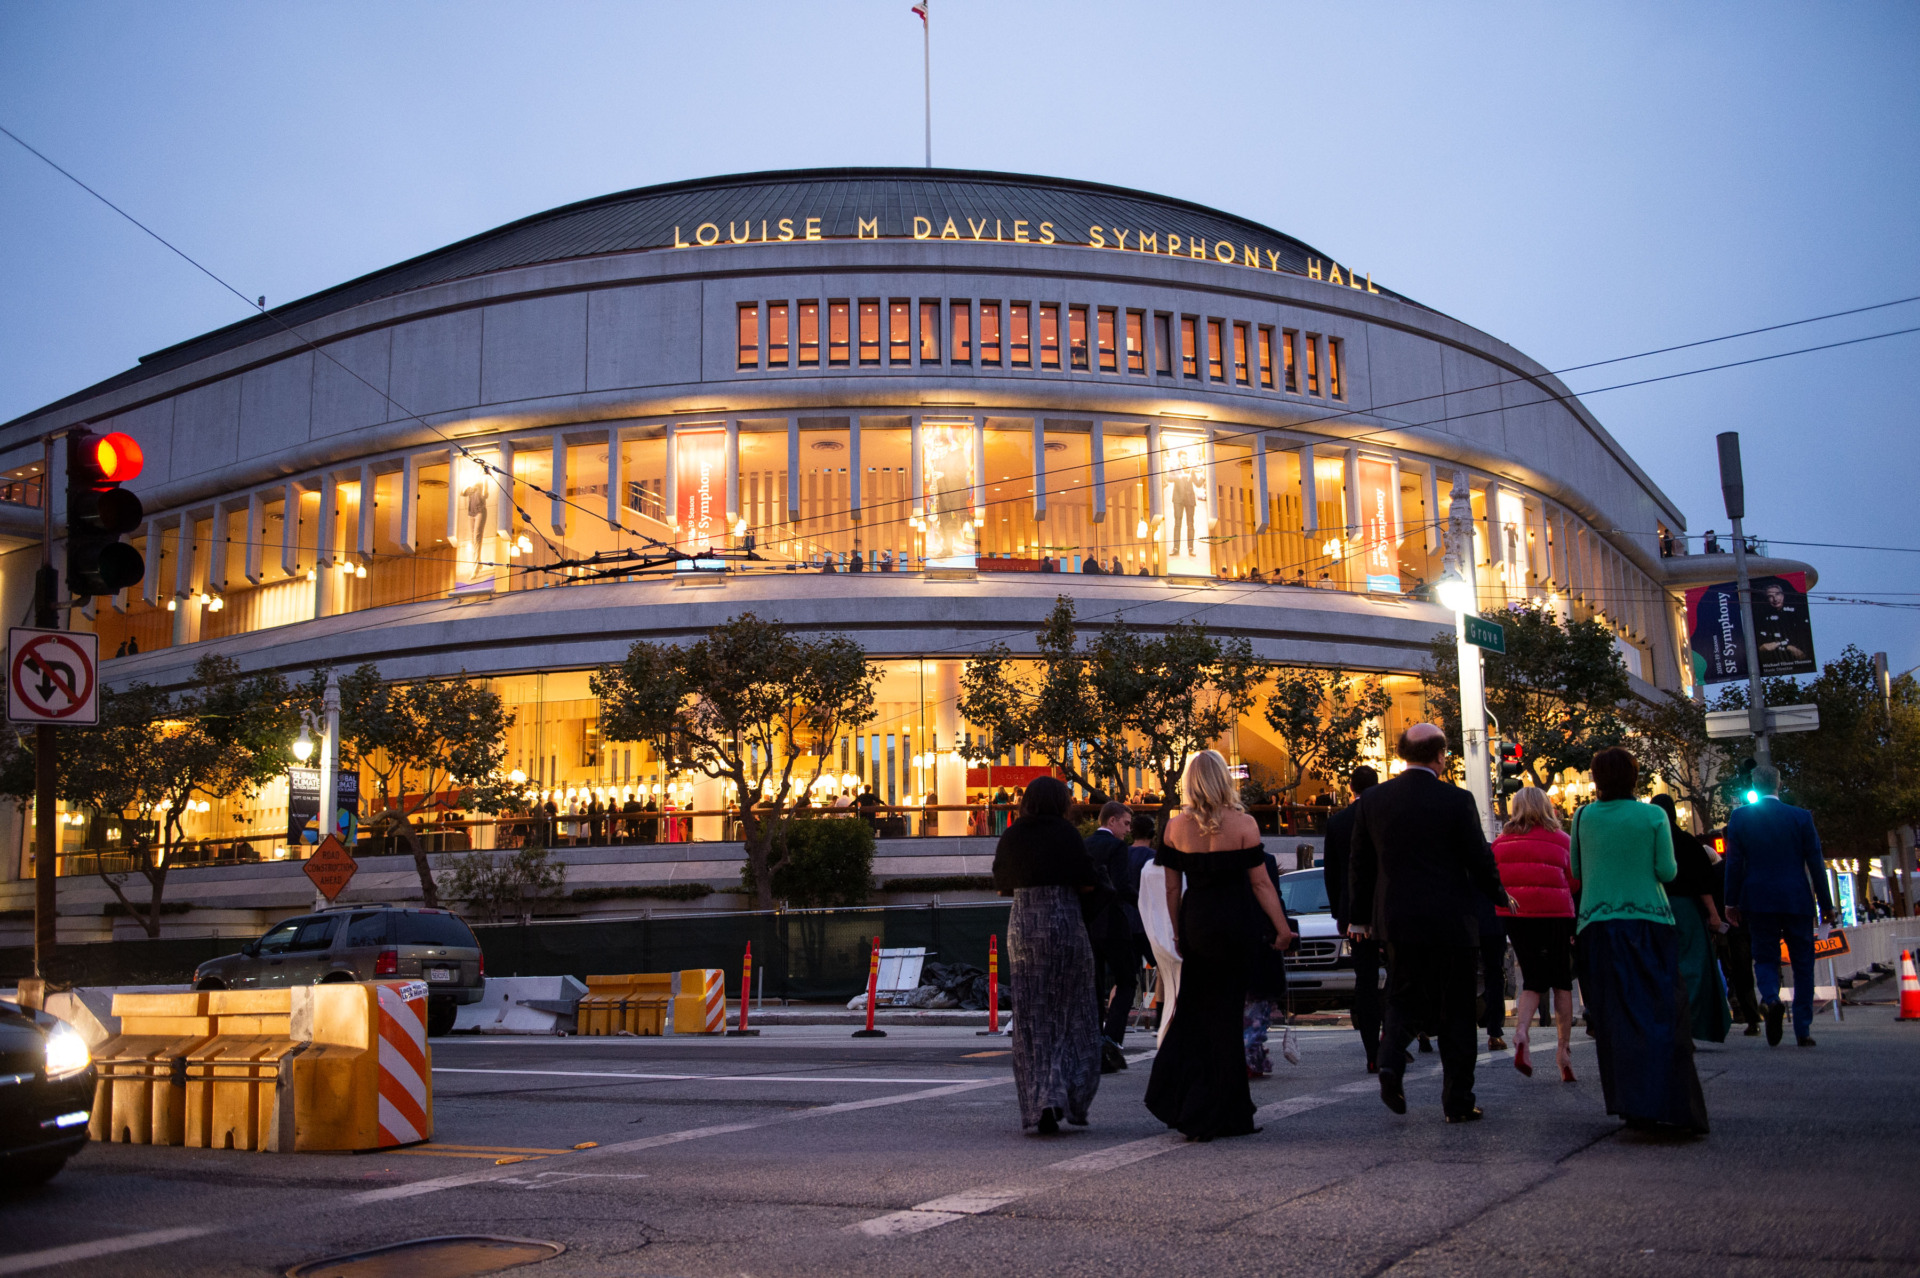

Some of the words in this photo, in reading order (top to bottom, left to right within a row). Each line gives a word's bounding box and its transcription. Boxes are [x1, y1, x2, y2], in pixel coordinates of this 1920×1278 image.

[675, 218, 822, 248] LOUISE
[858, 216, 878, 239] M
[913, 216, 1055, 245] DAVIES
[1089, 225, 1281, 271] SYMPHONY
[1307, 257, 1379, 294] HALL
[698, 460, 713, 529] Symphony
[1376, 488, 1389, 554] Symphony
[698, 531, 710, 547] SF
[1718, 592, 1736, 657] Symphony
[1470, 623, 1498, 645] Grove
[1724, 659, 1737, 674] SF
[293, 779, 320, 787] CLIMATE
[1715, 838, 1724, 853] 8
[322, 851, 340, 860] ROAD
[307, 863, 353, 872] CONSTRUCTION
[320, 876, 342, 885] AHEAD
[1814, 939, 1837, 952] OUR
